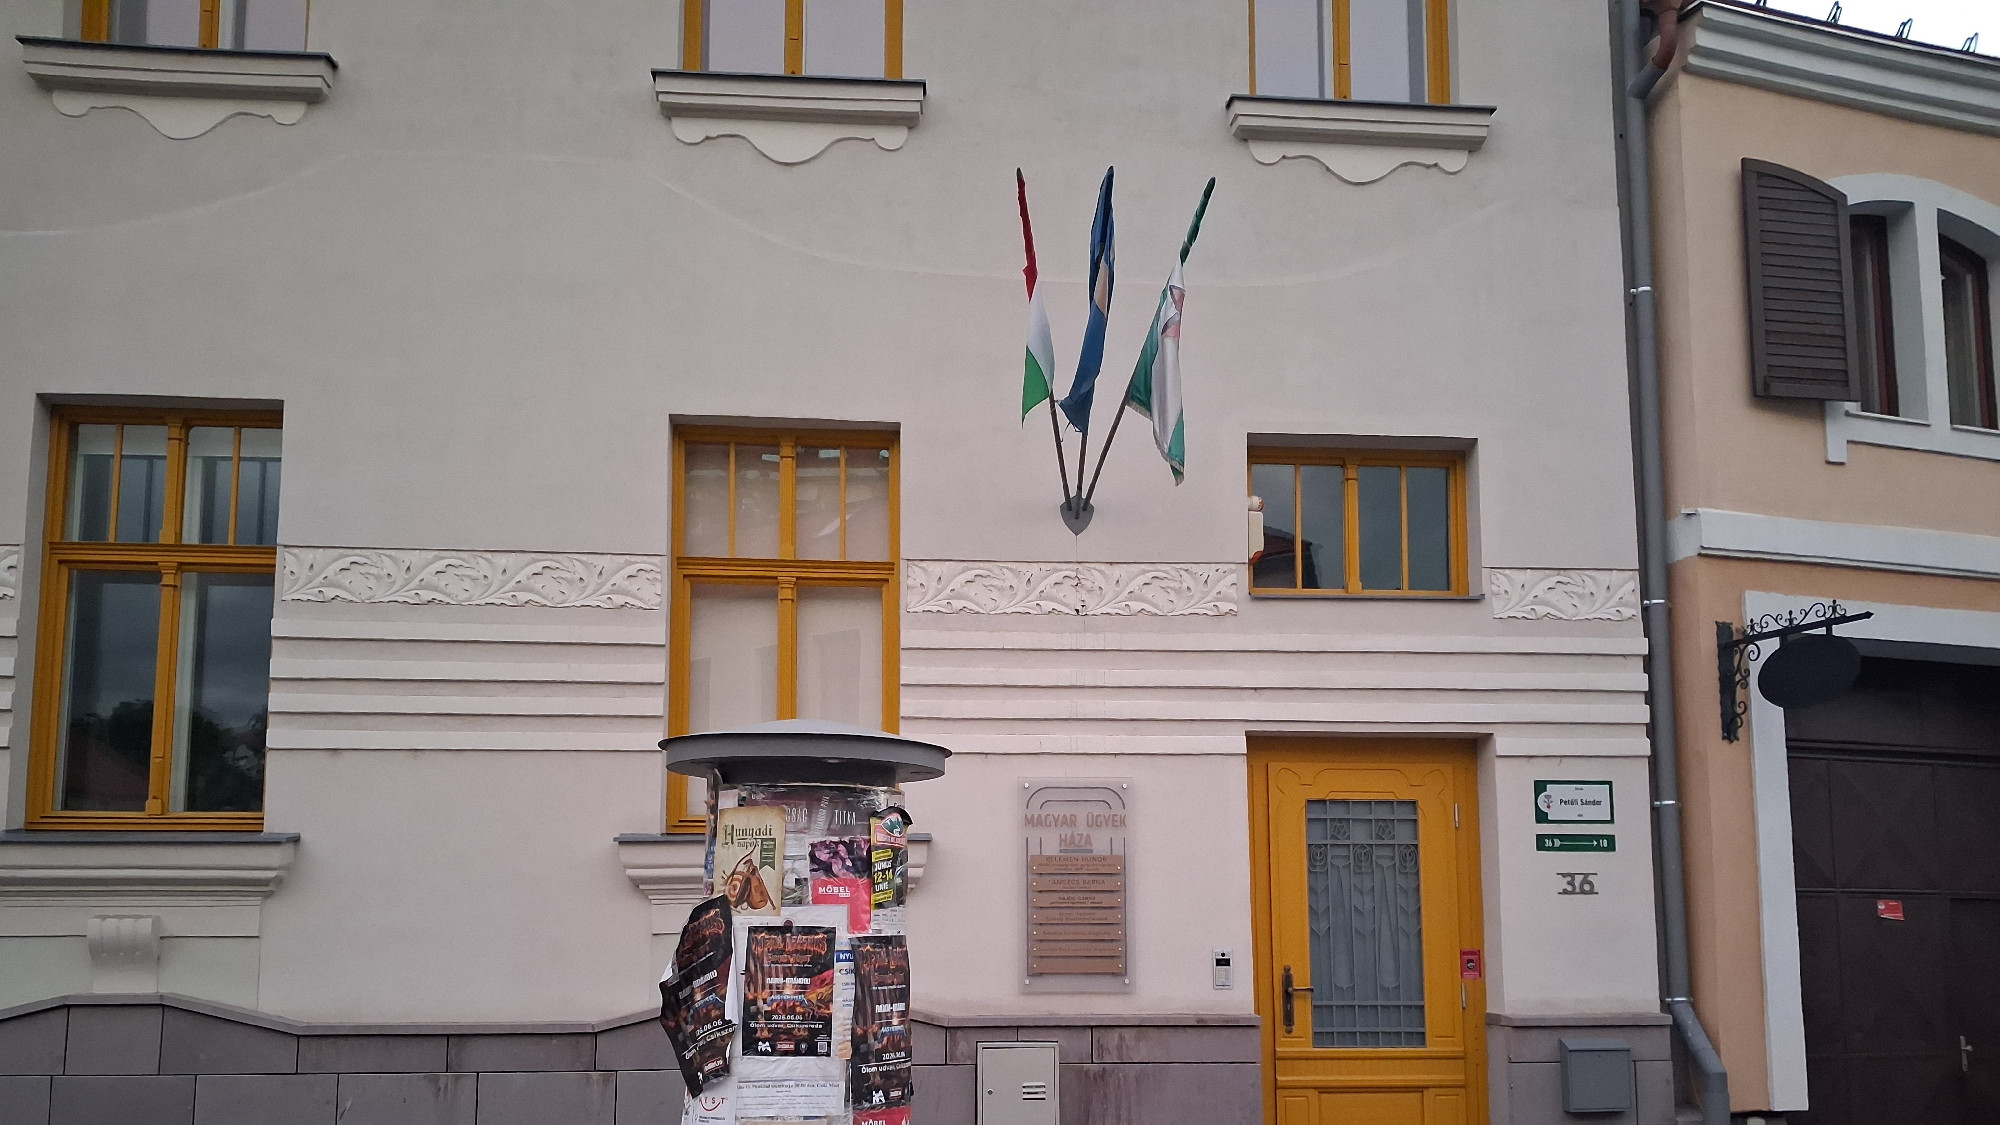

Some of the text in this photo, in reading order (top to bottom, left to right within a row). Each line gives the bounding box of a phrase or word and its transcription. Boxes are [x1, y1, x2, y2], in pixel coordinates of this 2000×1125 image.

[1580, 798, 1603, 806] Sándor
[1024, 811, 1127, 828] MAGYAR ÜGYEK
[721, 823, 773, 848] Hunyadi
[1059, 830, 1093, 847] HÁZA
[1544, 838, 1553, 848] 36
[873, 868, 893, 883] 12-14
[1560, 872, 1596, 895] 36
[839, 952, 854, 960] NYU
